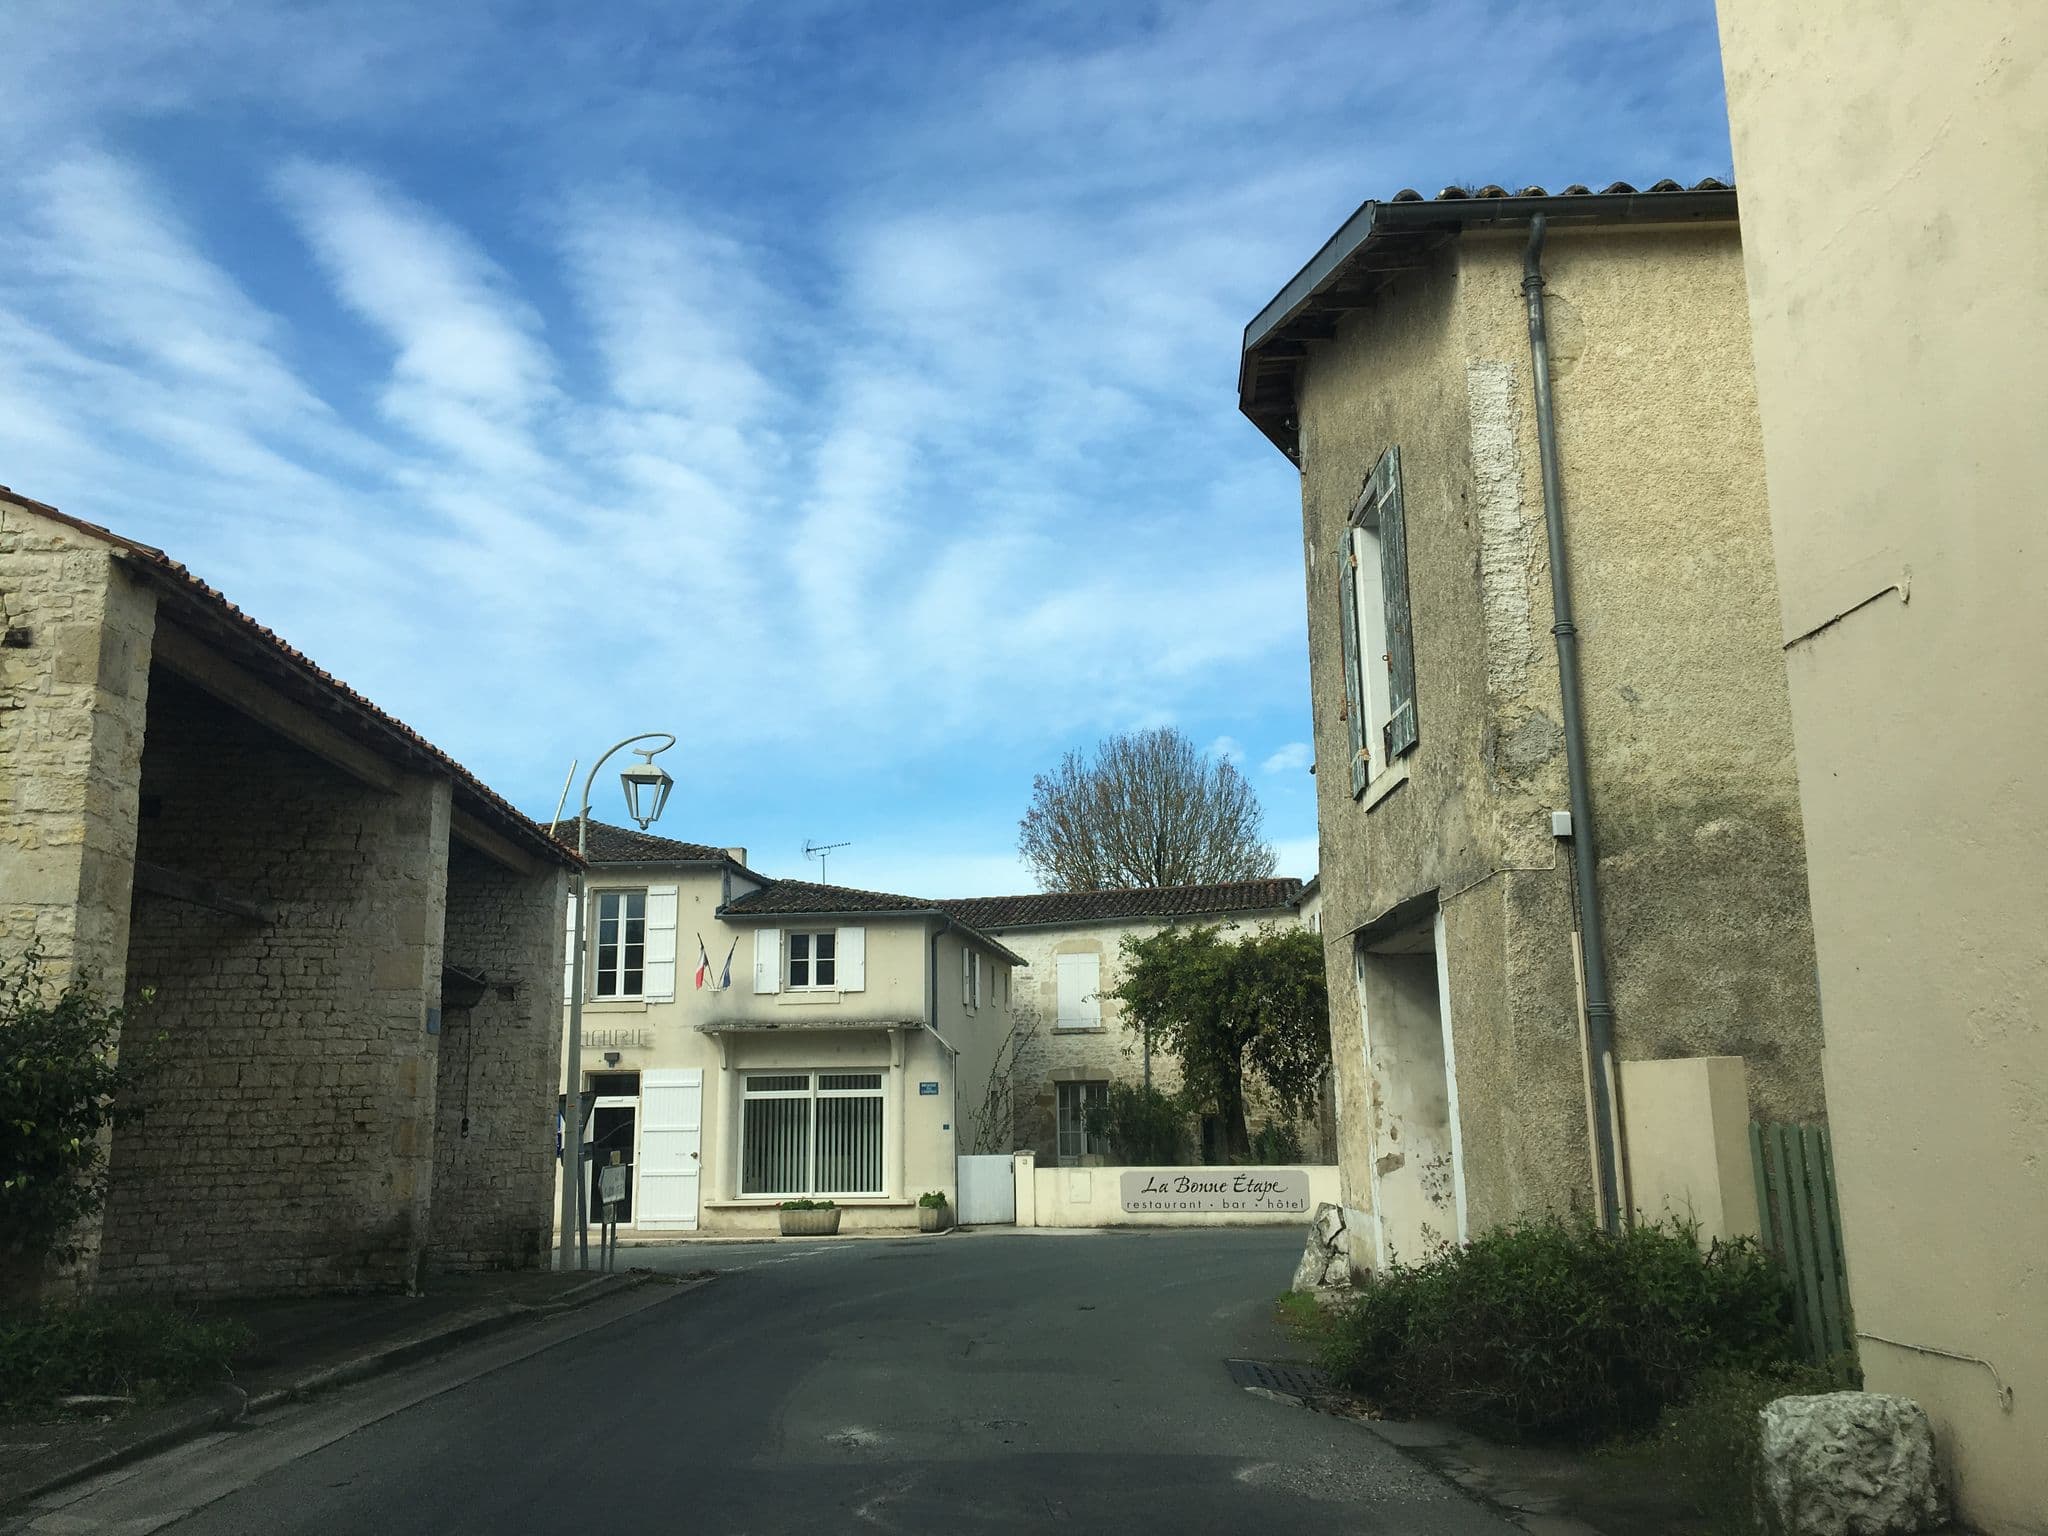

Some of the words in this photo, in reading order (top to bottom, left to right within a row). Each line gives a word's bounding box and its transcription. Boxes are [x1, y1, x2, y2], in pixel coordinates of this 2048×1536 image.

[1140, 1176, 1169, 1194] La
[1173, 1175, 1227, 1194] Bonne
[1233, 1173, 1289, 1202] Étape
[1126, 1200, 1202, 1209] restaurant
[1222, 1198, 1246, 1209] bar
[1267, 1198, 1304, 1209] hôtel
